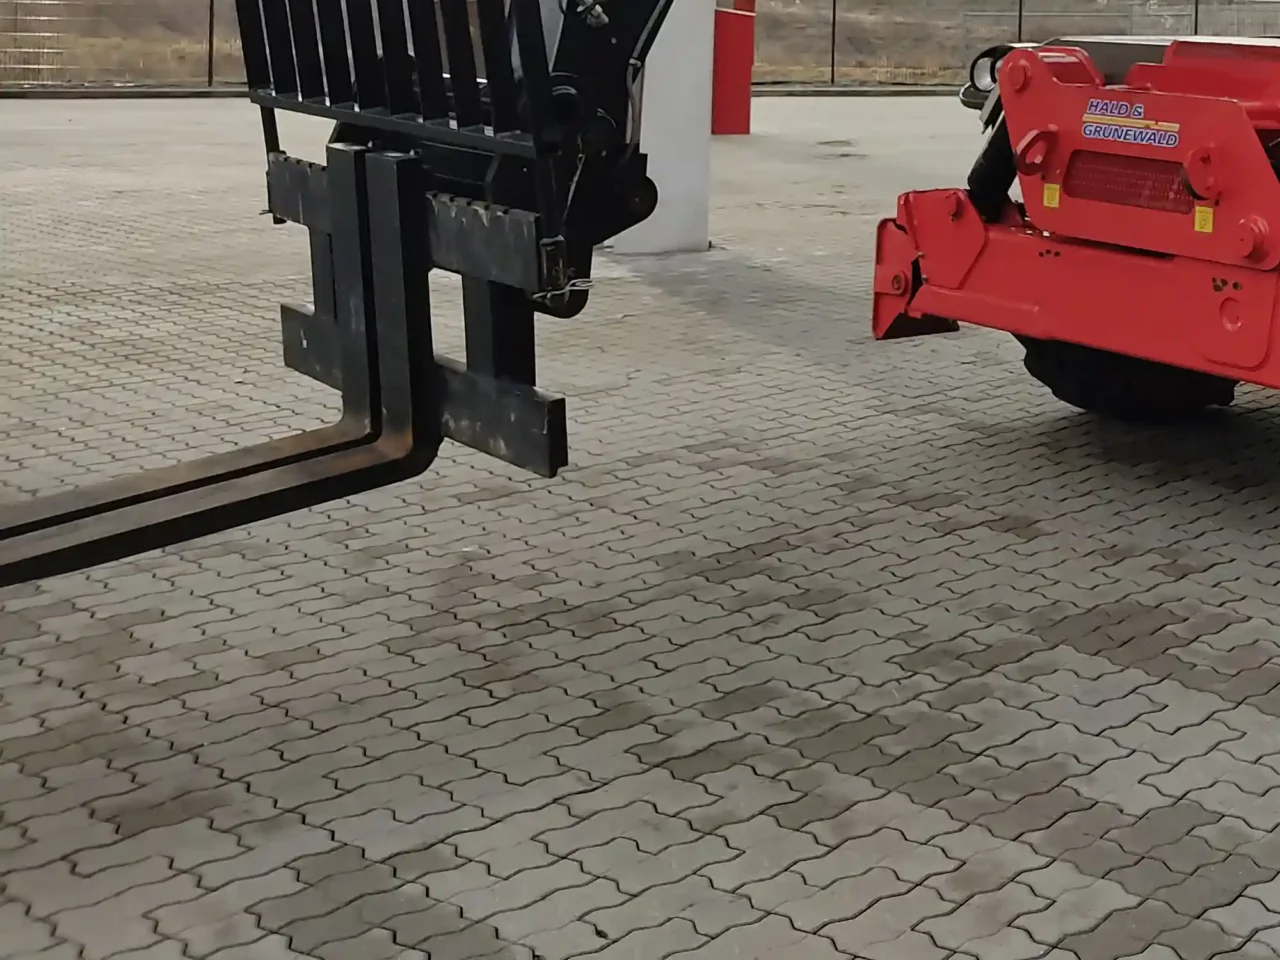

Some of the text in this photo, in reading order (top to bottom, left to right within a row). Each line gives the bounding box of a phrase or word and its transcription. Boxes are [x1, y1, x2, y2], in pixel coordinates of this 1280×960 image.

[1087, 99, 1144, 119] HALD &
[1082, 123, 1179, 148] GRUNEWALD
